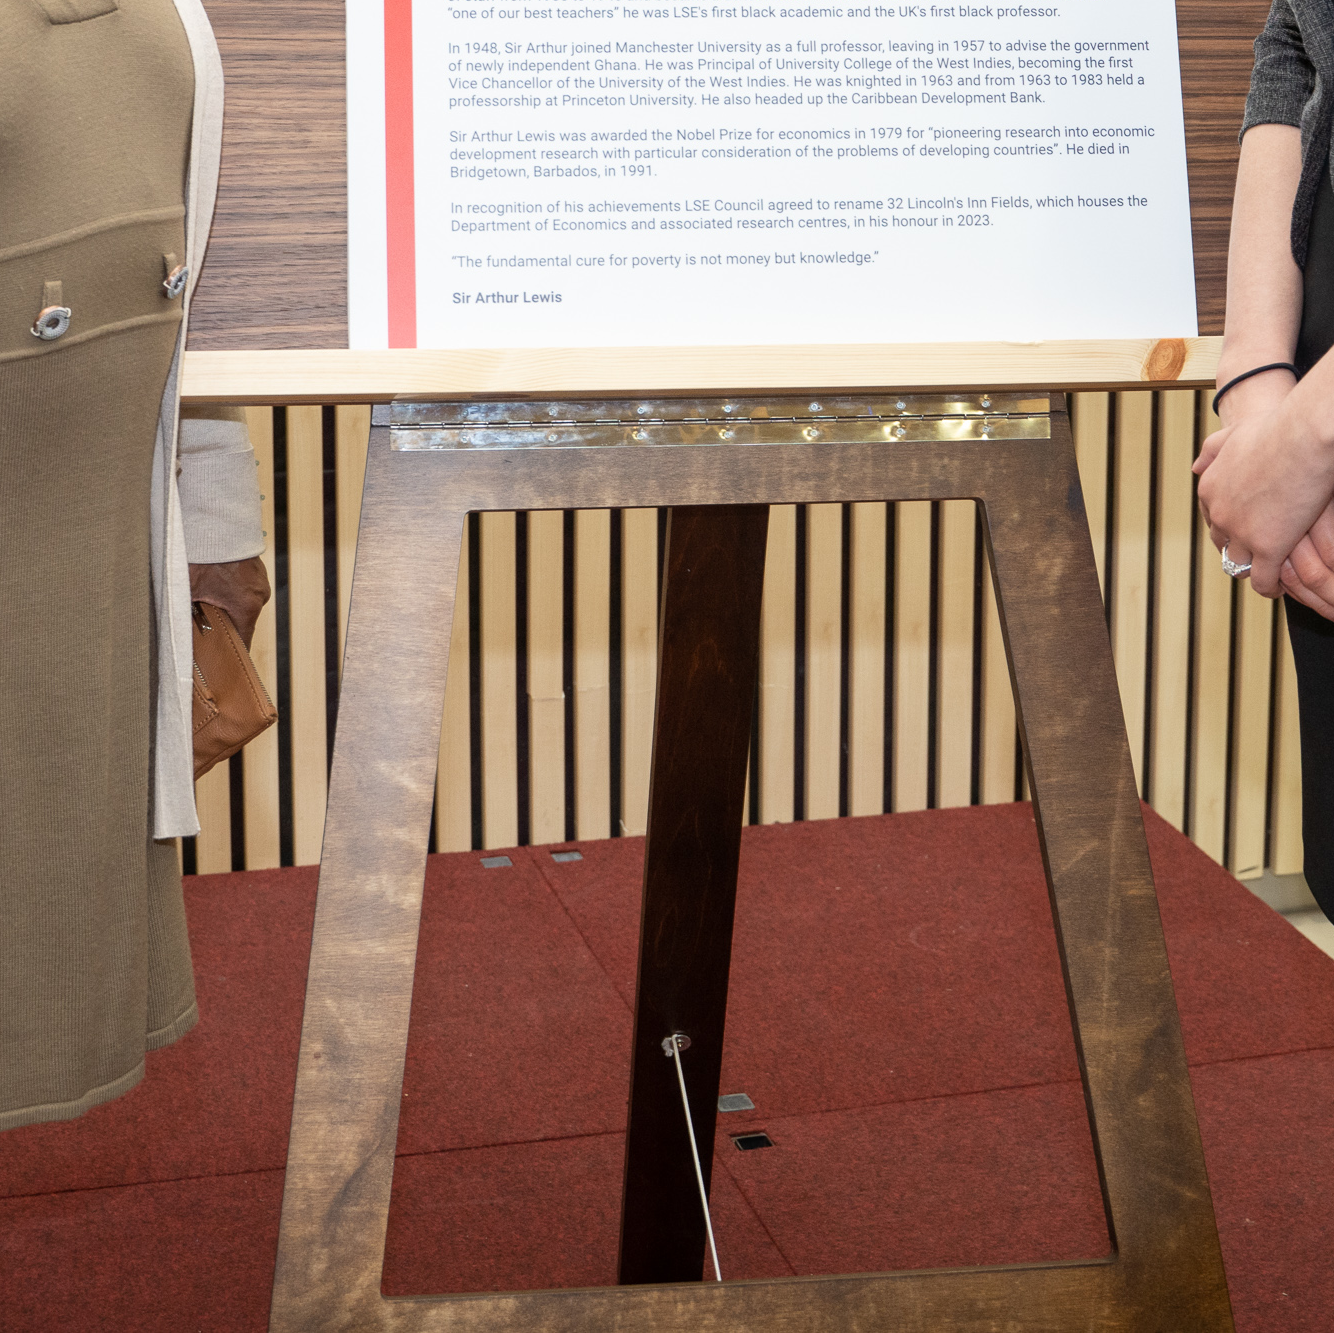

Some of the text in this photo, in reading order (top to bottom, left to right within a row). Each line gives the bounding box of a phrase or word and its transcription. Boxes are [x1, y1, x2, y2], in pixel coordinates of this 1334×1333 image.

[480, 6, 495, 20] of
[498, 9, 521, 19] our
[523, 6, 553, 19] best
[622, 6, 640, 19] he
[642, 8, 670, 19] was
[711, 5, 738, 19] first
[740, 5, 777, 18] black
[779, 5, 844, 18] academic
[846, 5, 871, 18] and
[873, 5, 896, 18] the
[929, 4, 956, 18] first
[958, 4, 994, 18] black
[996, 4, 1061, 20] professor.
[448, 38, 1150, 57] In 1948, Sir Arthur joined Manchester University as a full professor, leaving in 1957 to advise the government
[448, 90, 1045, 110] professorship at Princeton University. He also headed up the Caribbean Development Bank.
[450, 164, 658, 181] Bridgetown, Barbados, in 1991.
[451, 213, 995, 235] Department of Economics and associated research centres, in his honour in 2023.
[486, 254, 572, 268] fundamental
[575, 256, 606, 267] cure
[608, 253, 628, 267] for
[631, 254, 682, 269] poverty
[685, 253, 697, 266] is
[700, 253, 723, 266] not
[725, 254, 771, 268] money
[774, 251, 797, 265] but
[452, 290, 563, 305] Sir Arthur Lewis
